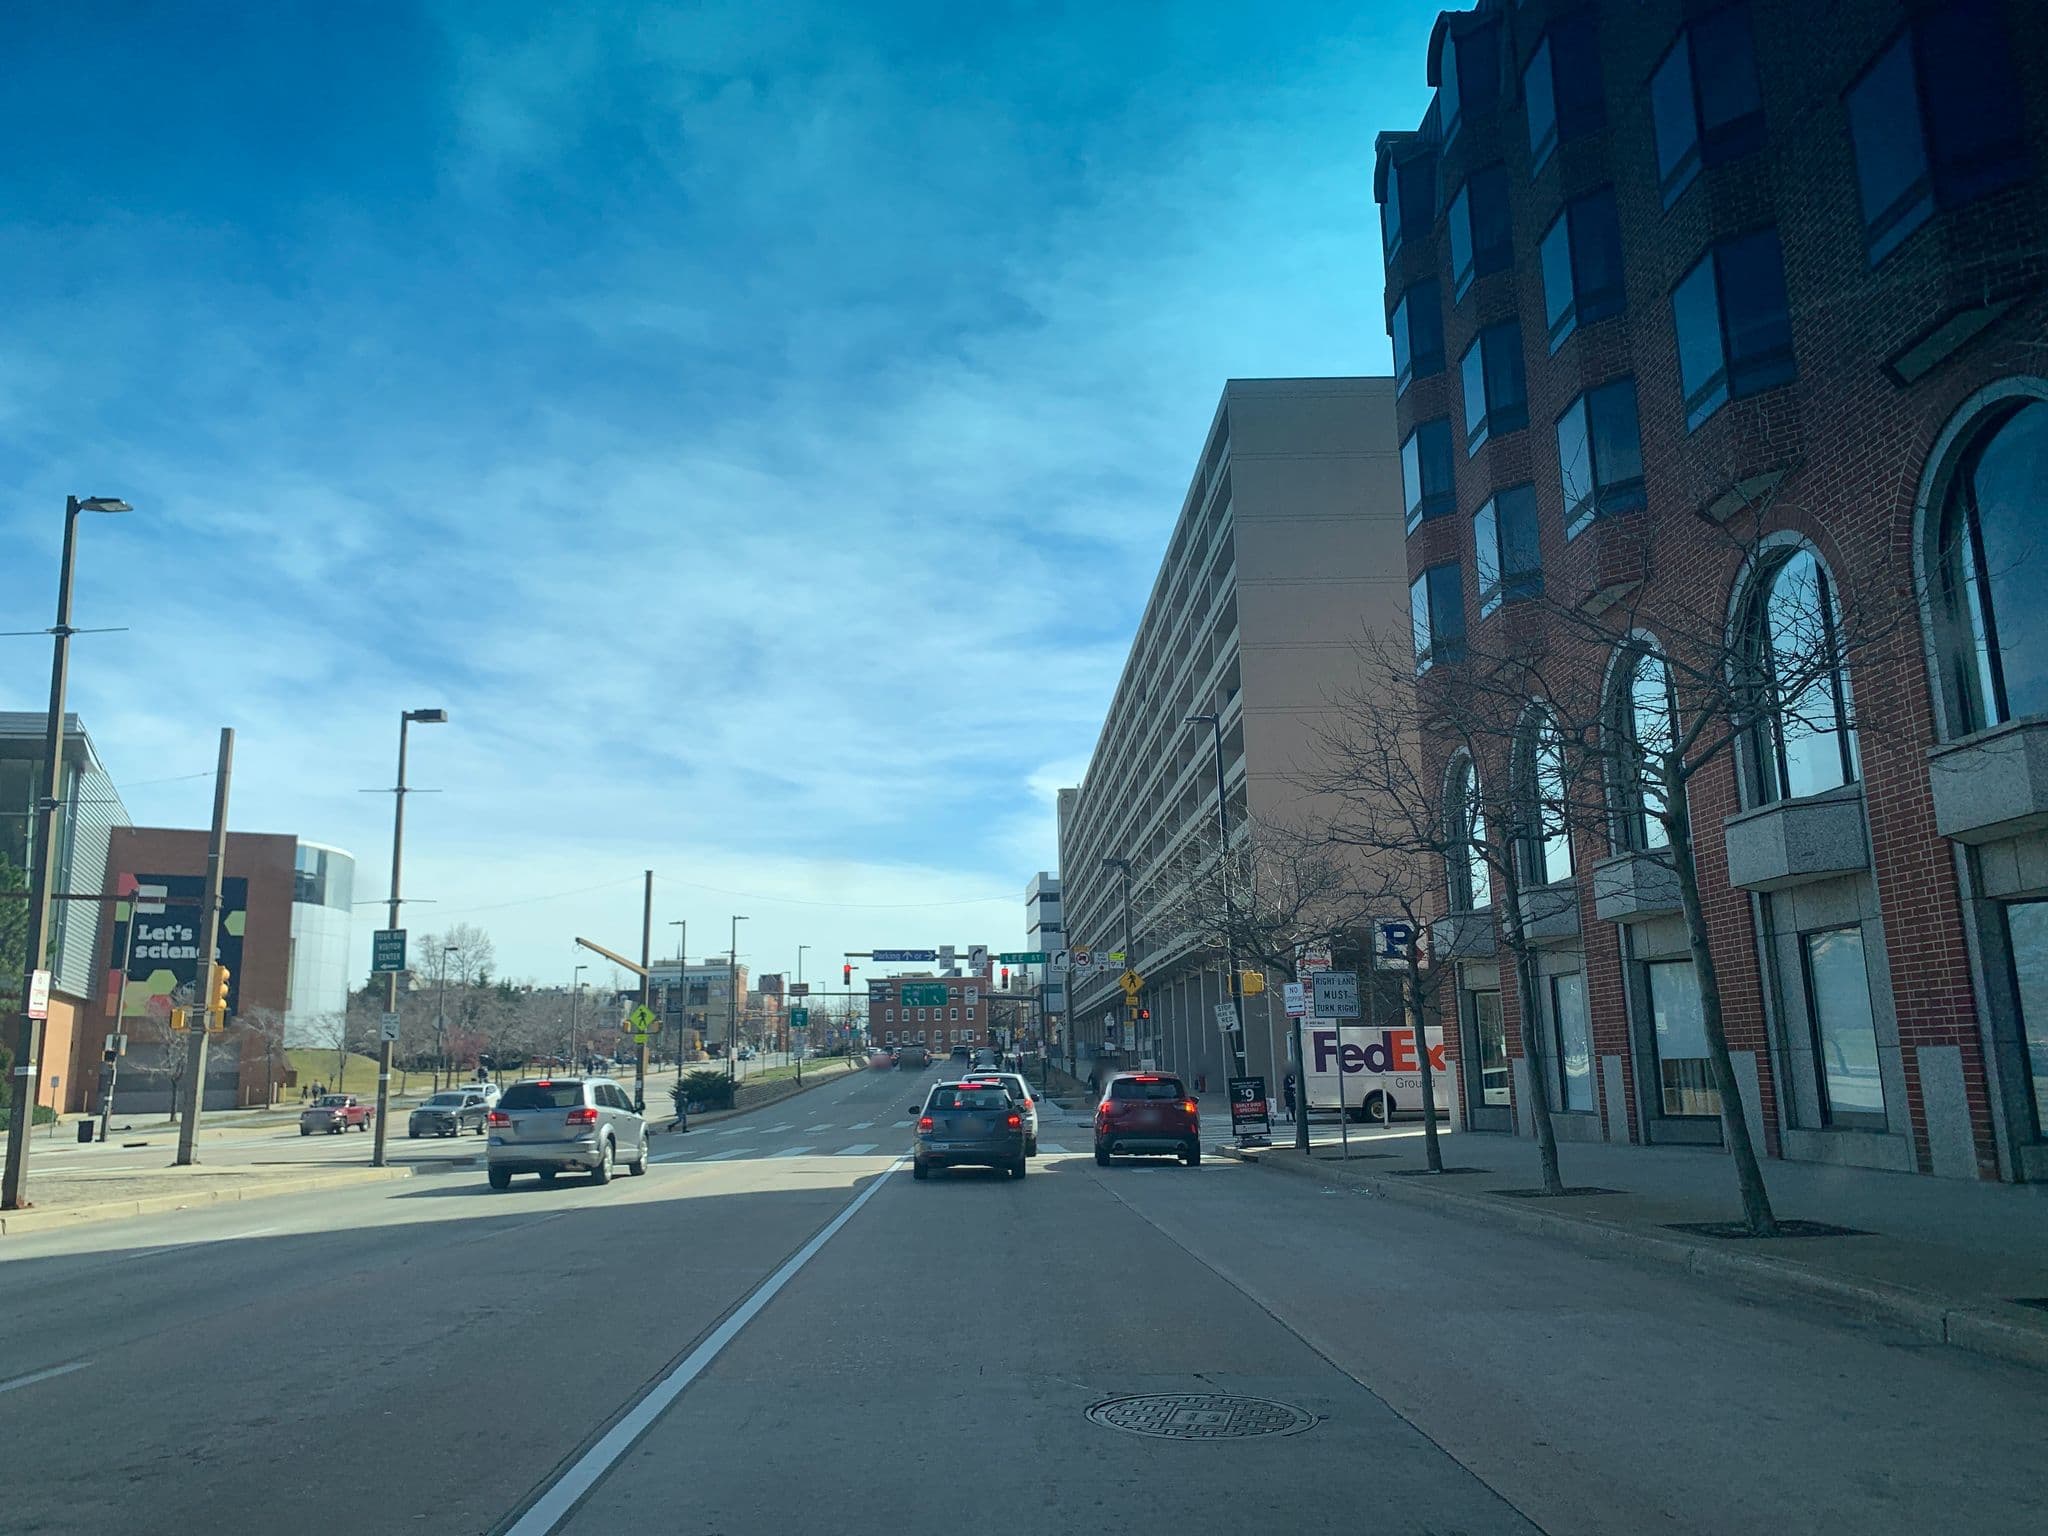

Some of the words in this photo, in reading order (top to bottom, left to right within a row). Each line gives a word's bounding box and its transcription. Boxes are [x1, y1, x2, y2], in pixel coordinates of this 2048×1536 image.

[138, 924, 192, 941] Let's
[135, 942, 221, 959] scien
[873, 951, 900, 960] Parking
[378, 952, 401, 961] CENTER
[1005, 954, 1024, 963] LEE
[1032, 953, 1041, 961] ST
[1315, 977, 1335, 986] RIGHT
[1338, 976, 1355, 986] LANE
[1289, 986, 1298, 994] NO
[1323, 990, 1348, 1000] MUST
[1217, 1004, 1232, 1012] STOP
[1316, 1004, 1335, 1012] TURN
[1338, 1004, 1357, 1012] RIGHT
[1313, 1030, 1446, 1073] FedEx
[1396, 1077, 1436, 1089] Groud
[1240, 1088, 1255, 1102] $9
